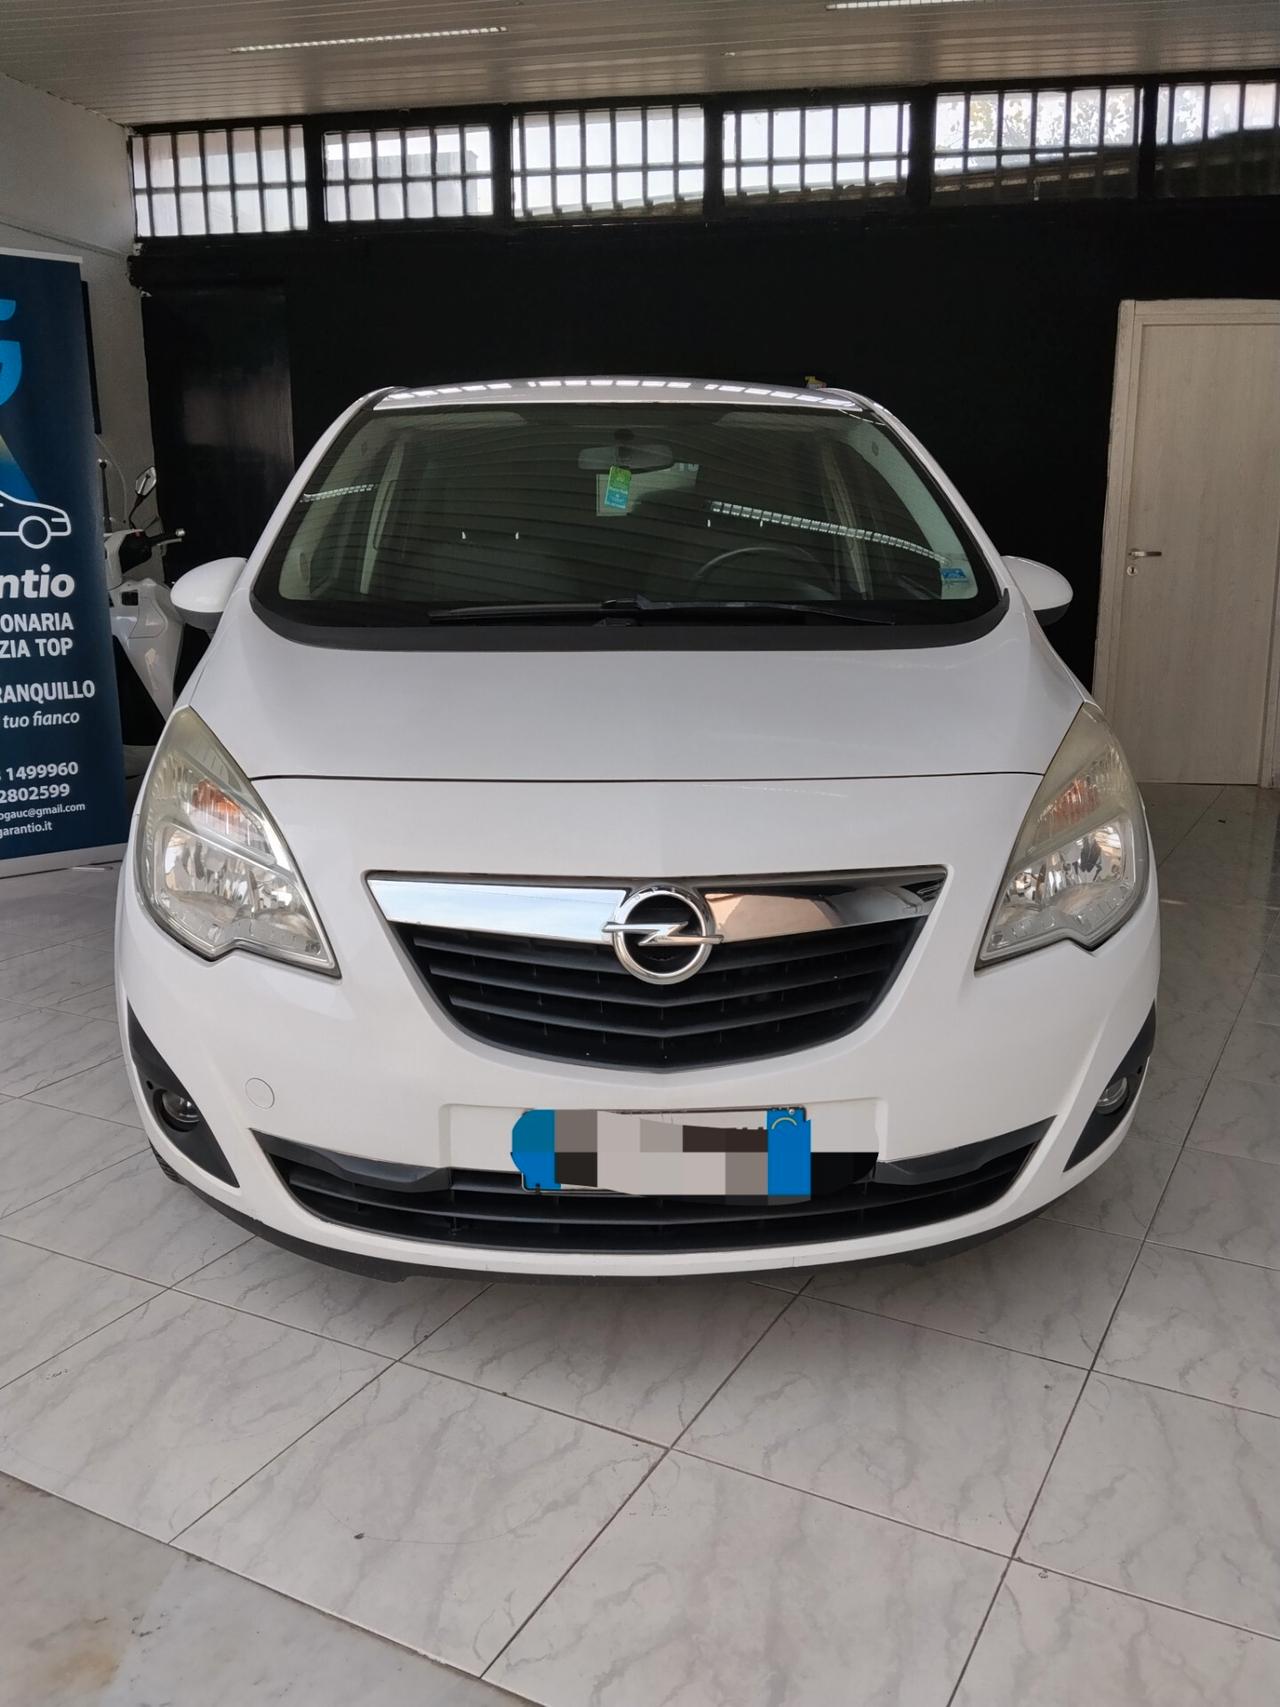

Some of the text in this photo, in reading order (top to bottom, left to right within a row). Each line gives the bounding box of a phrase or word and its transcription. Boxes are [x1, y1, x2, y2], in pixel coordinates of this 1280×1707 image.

[0, 612, 74, 633] ONARIA
[0, 637, 73, 659] ZIA TOP
[0, 680, 95, 704] ANQUILLO
[3, 710, 80, 729] tuo fianco
[6, 761, 79, 781] 1499960
[0, 783, 70, 804] 2802599
